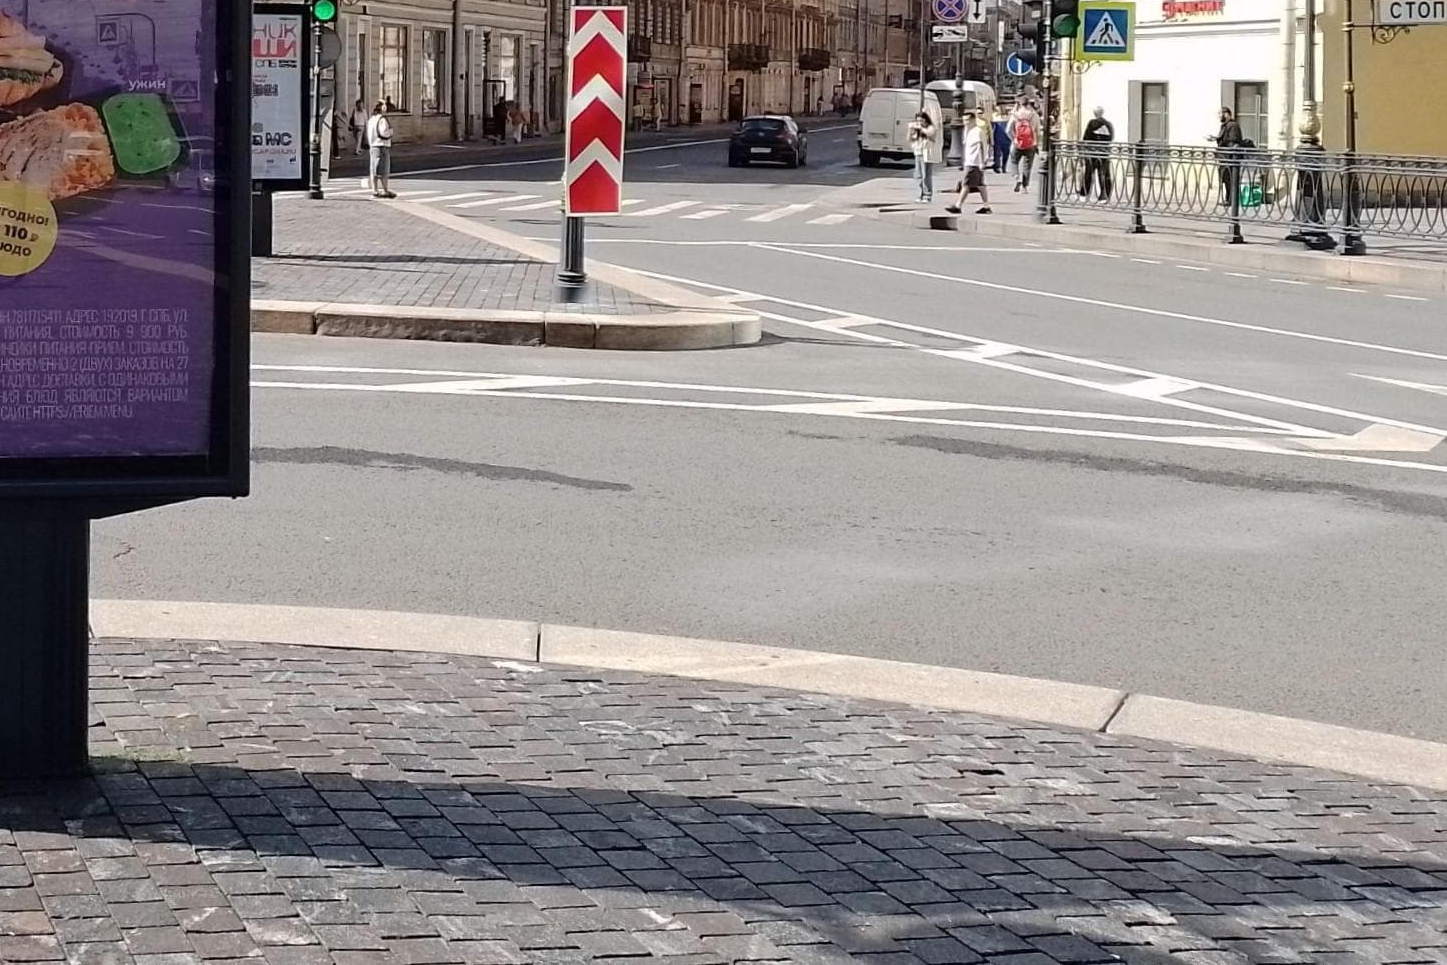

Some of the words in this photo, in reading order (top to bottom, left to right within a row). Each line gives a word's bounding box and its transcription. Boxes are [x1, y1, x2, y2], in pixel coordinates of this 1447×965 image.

[1390, 1, 1445, 19] СТОП
[128, 79, 165, 91] ужин
[5, 225, 28, 240] 110
